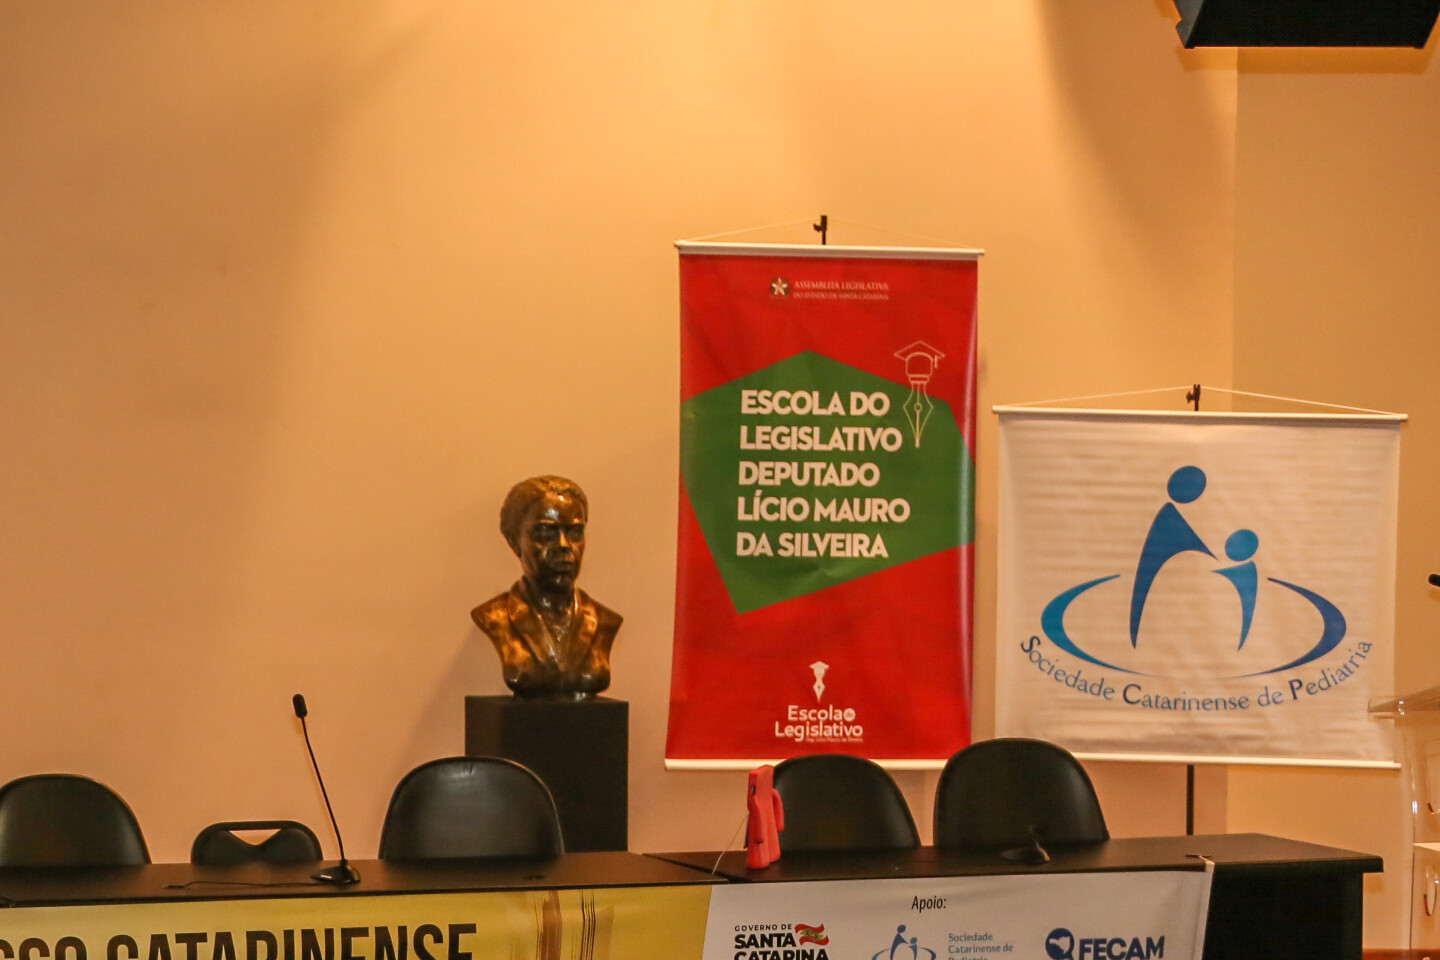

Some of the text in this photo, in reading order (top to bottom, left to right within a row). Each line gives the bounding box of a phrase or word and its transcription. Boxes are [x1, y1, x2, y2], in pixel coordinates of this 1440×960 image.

[741, 389, 890, 416] ESCOLA DO
[740, 425, 903, 452] LEGISLATIVO
[738, 460, 880, 487] DEPUTADO
[737, 490, 910, 523] LÍCIO MAURO
[736, 531, 889, 558] DA SILVEIRA
[1020, 635, 1374, 711] Sociedade Catarinense de Pediatria
[787, 704, 842, 721] Escola
[775, 721, 863, 742] Legislativo
[911, 895, 947, 913] Apoio:
[734, 924, 778, 932] GOVERNO
[948, 932, 993, 942] Sociedade
[734, 932, 796, 949] SANTA
[948, 943, 1013, 954] Catarinense de
